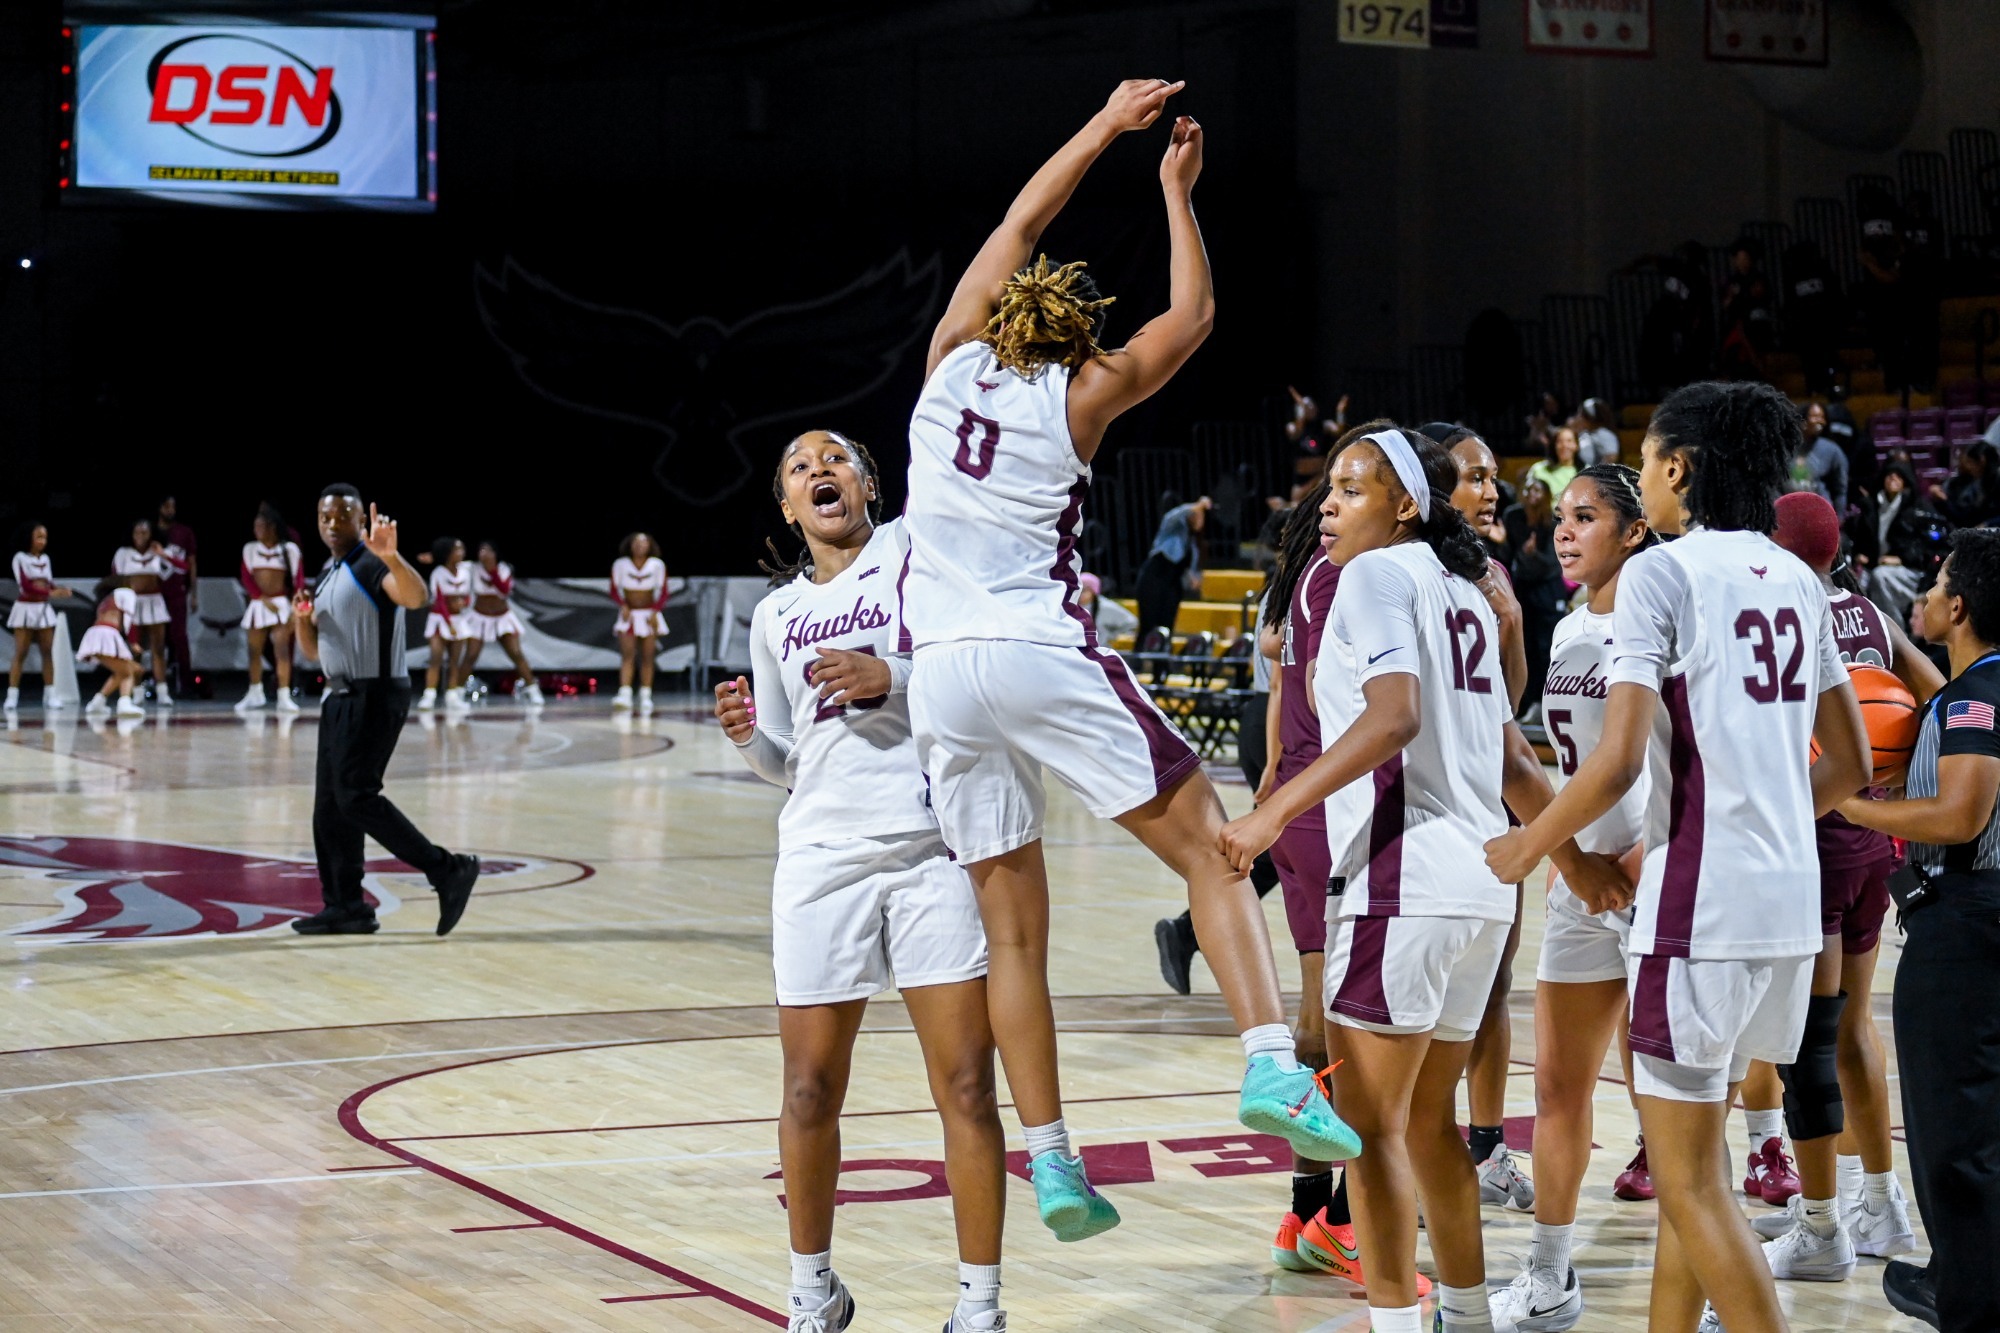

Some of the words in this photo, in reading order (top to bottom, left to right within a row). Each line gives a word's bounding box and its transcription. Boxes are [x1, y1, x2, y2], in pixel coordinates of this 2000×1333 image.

[1346, 5, 1425, 38] 1974
[150, 65, 334, 126] DSN
[221, 170, 271, 182] SPORTS
[275, 172, 338, 185] NETWORK
[952, 407, 1000, 481] 0
[782, 595, 892, 662] Hawks
[1444, 605, 1493, 695] 12
[1733, 607, 1807, 705] 32
[1548, 709, 1578, 777] 5
